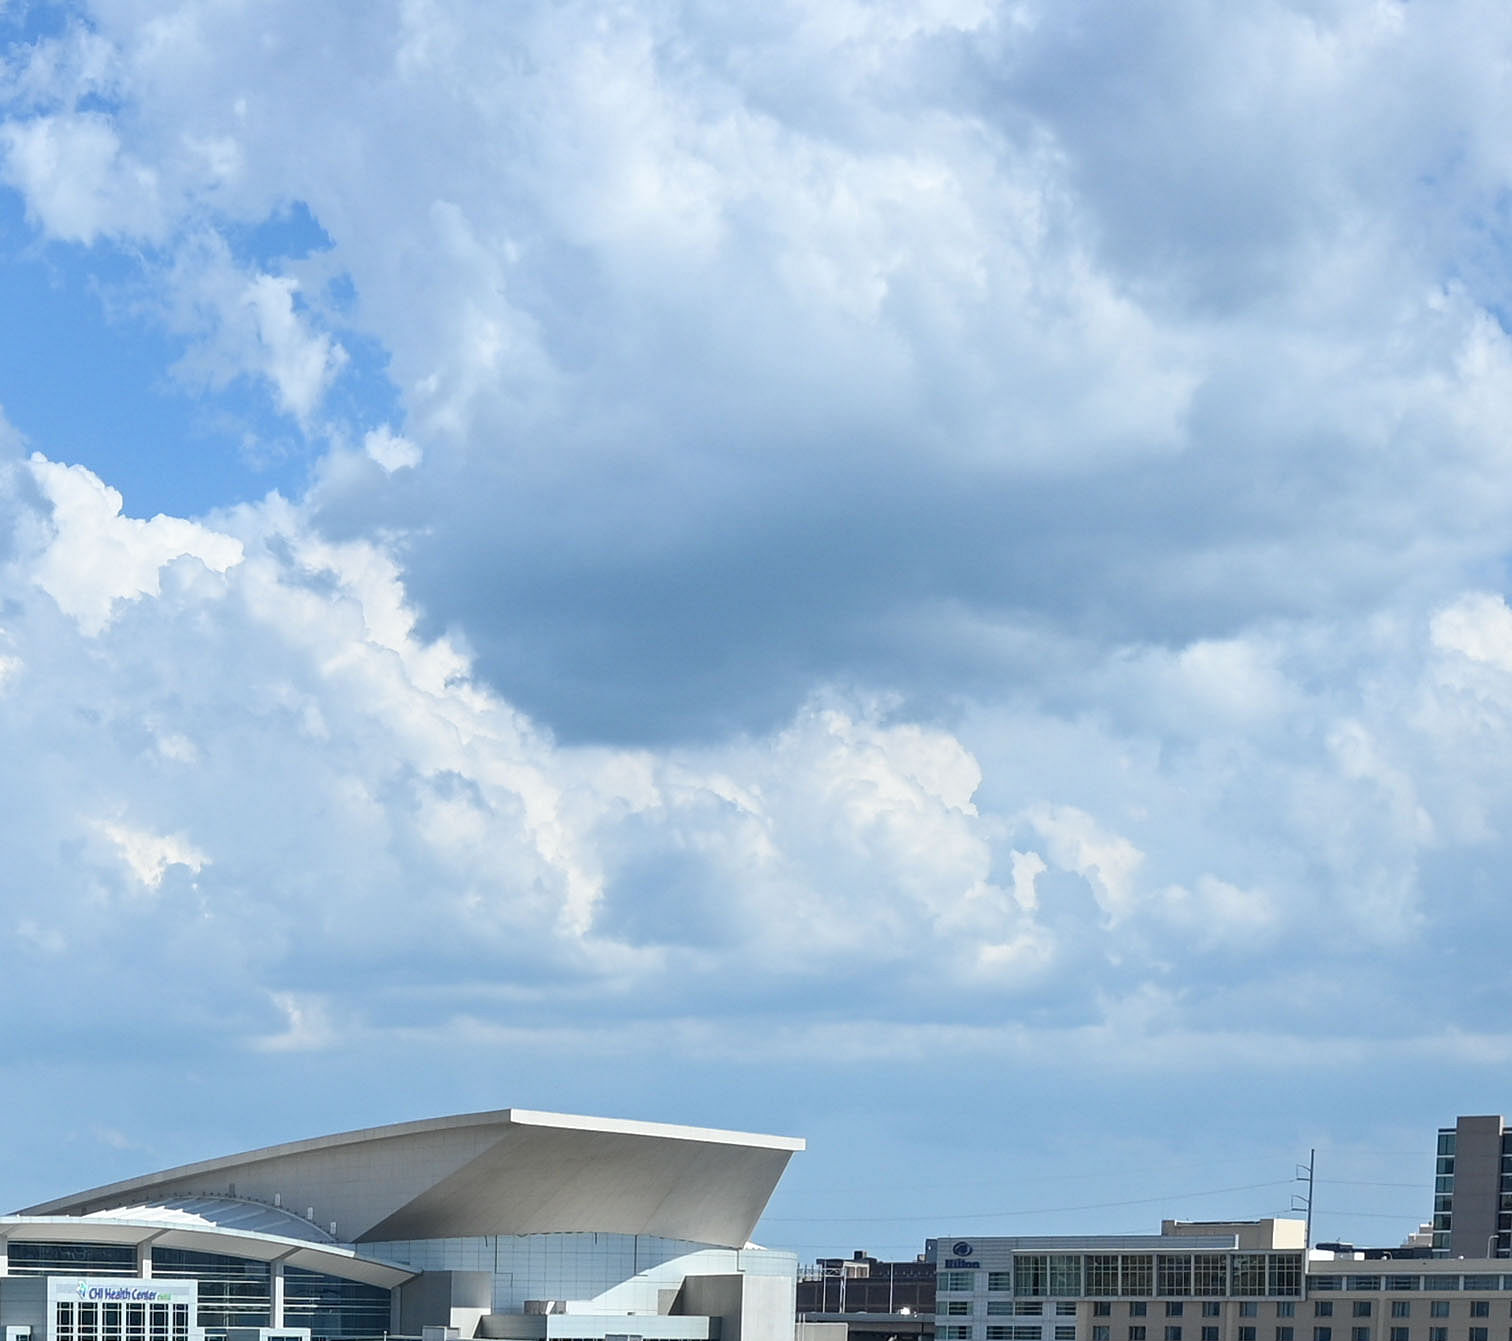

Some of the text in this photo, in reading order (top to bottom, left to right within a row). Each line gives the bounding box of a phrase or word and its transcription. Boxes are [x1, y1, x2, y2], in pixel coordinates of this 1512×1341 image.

[944, 1259, 980, 1269] Hilton
[88, 1287, 103, 1300] CHI
[105, 1287, 131, 1300] Health
[131, 1289, 157, 1300] Center
